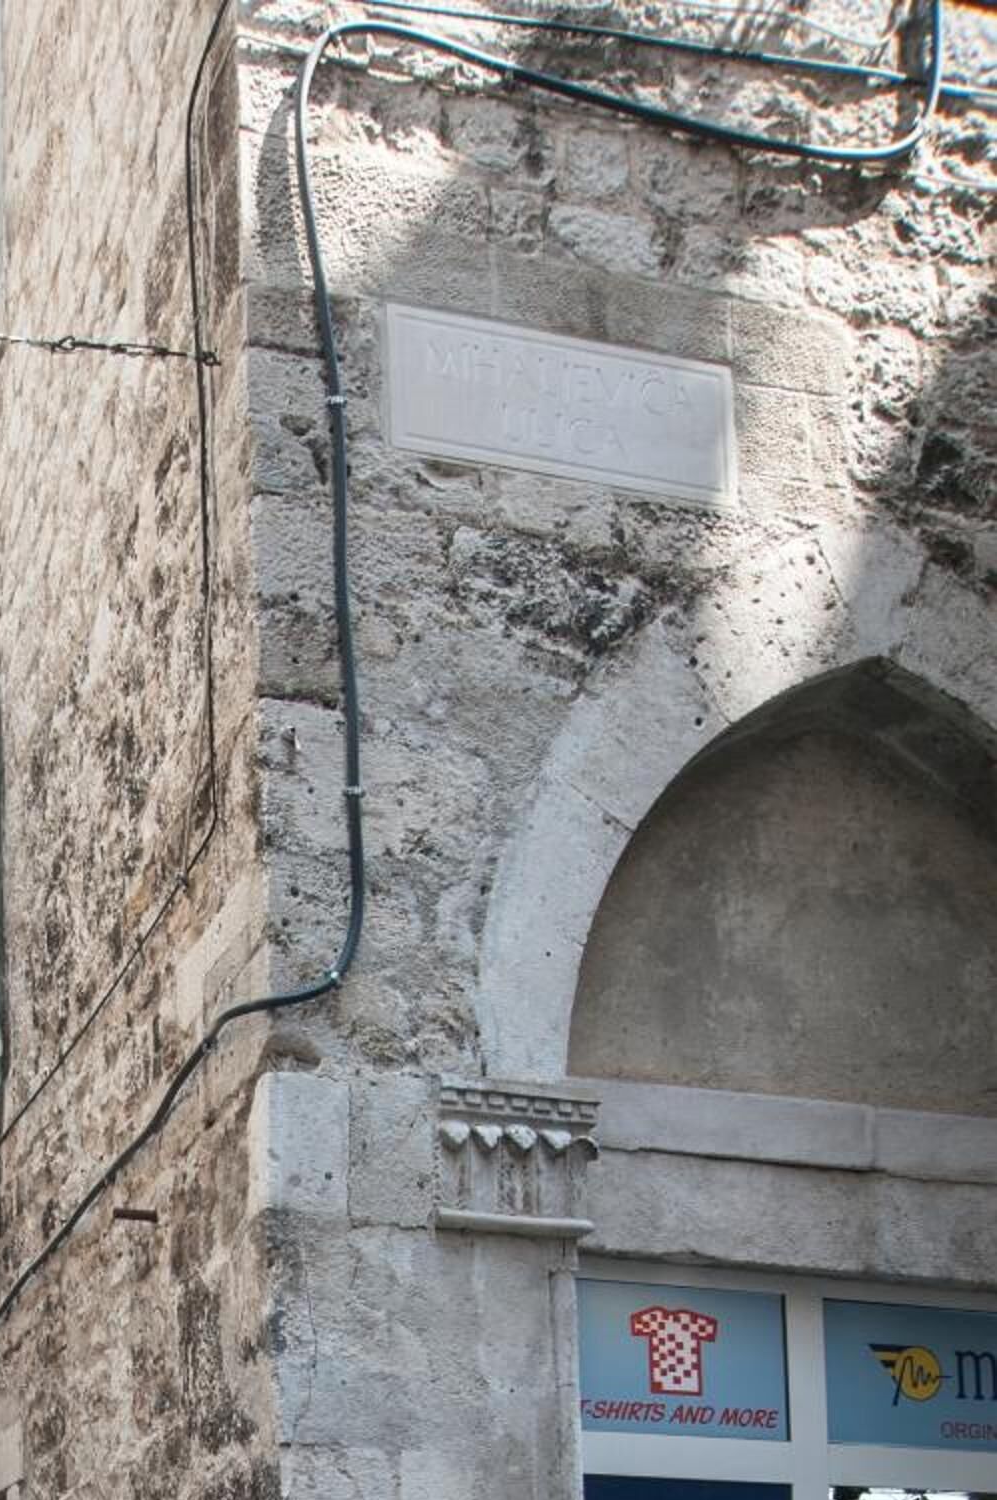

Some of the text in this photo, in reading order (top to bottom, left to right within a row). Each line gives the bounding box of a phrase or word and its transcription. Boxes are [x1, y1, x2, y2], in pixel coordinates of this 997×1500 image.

[500, 400, 629, 463] ULICA
[670, 1405, 714, 1426] AND
[719, 1407, 779, 1430] MORE
